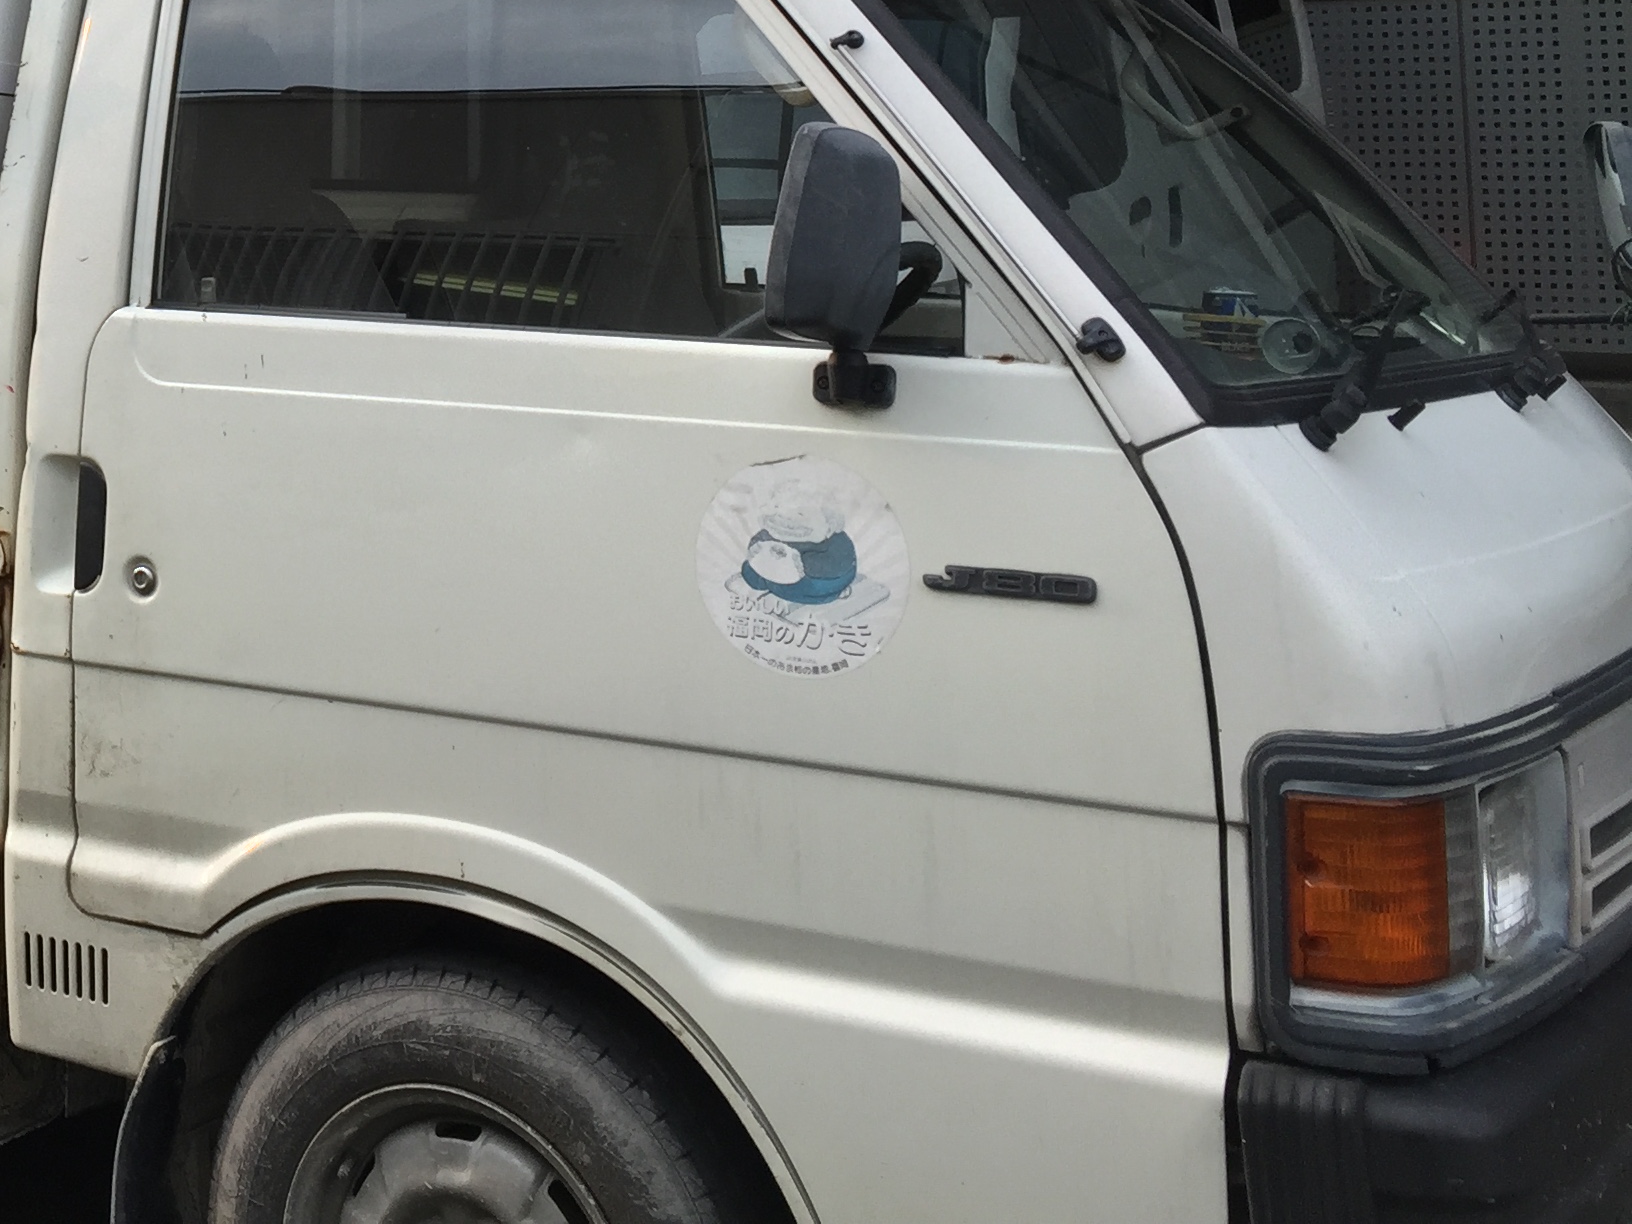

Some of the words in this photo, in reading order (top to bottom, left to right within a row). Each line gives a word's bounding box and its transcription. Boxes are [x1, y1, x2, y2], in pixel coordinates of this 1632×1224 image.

[729, 595, 792, 617] おいしい
[726, 613, 872, 657] 福岡のかき
